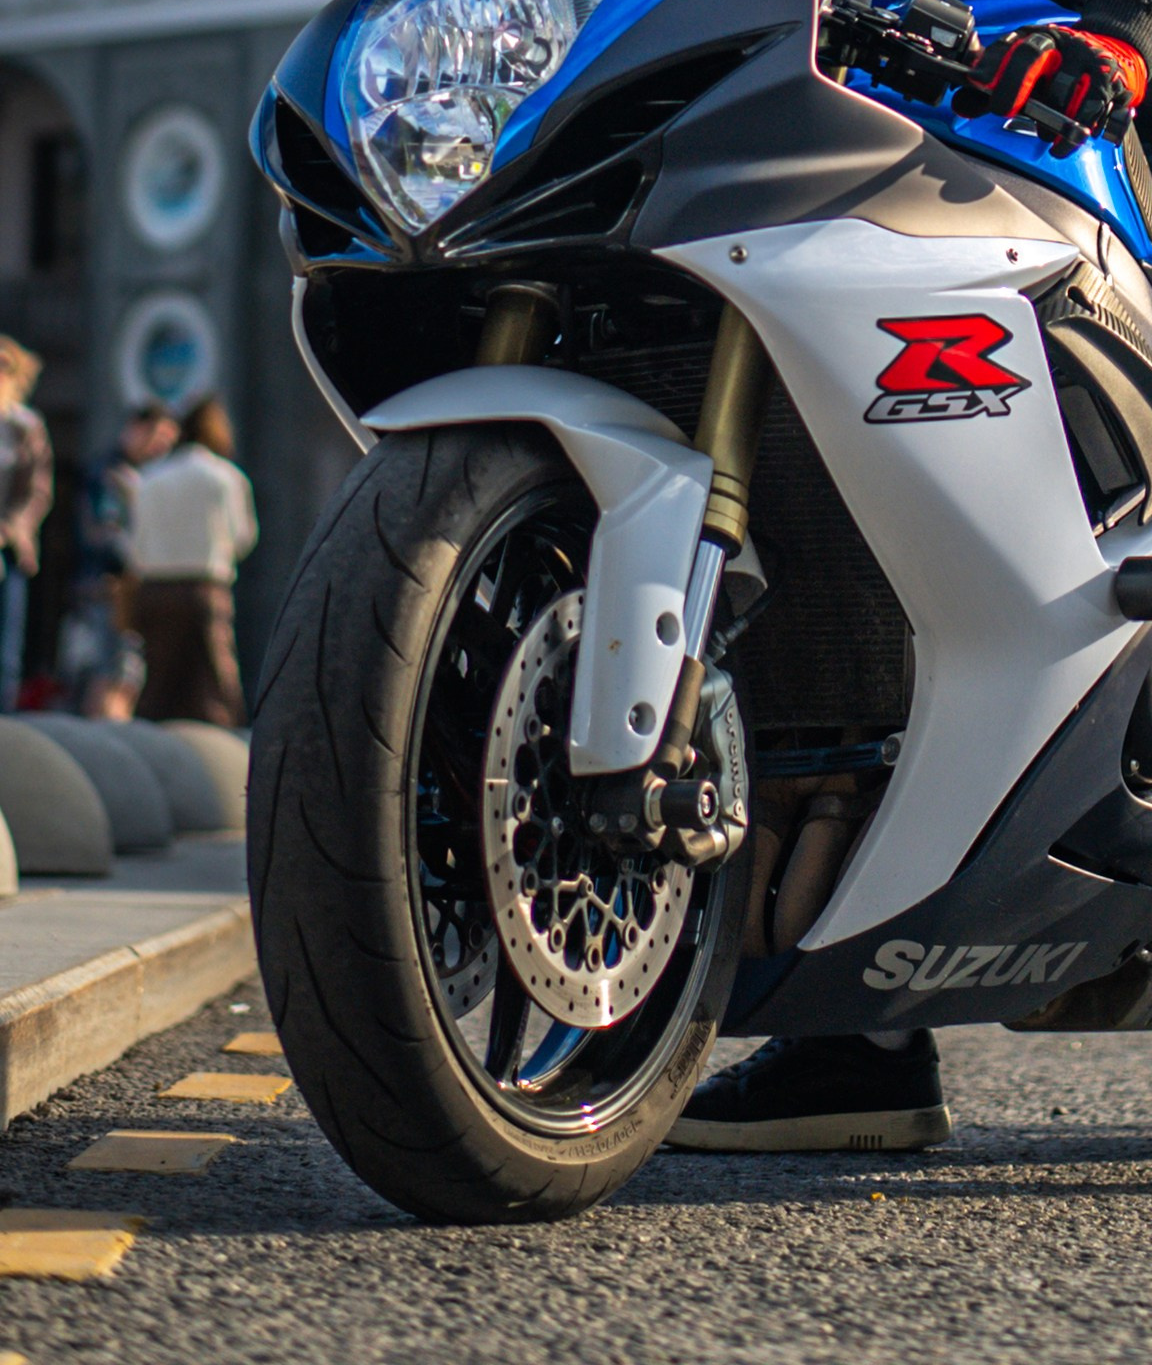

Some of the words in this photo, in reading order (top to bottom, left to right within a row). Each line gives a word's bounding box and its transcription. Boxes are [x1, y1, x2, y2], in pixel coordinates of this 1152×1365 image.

[876, 313, 1032, 393] R
[864, 388, 1022, 424] GSX
[725, 705, 745, 817] brembo
[862, 939, 1089, 991] SUZUKI
